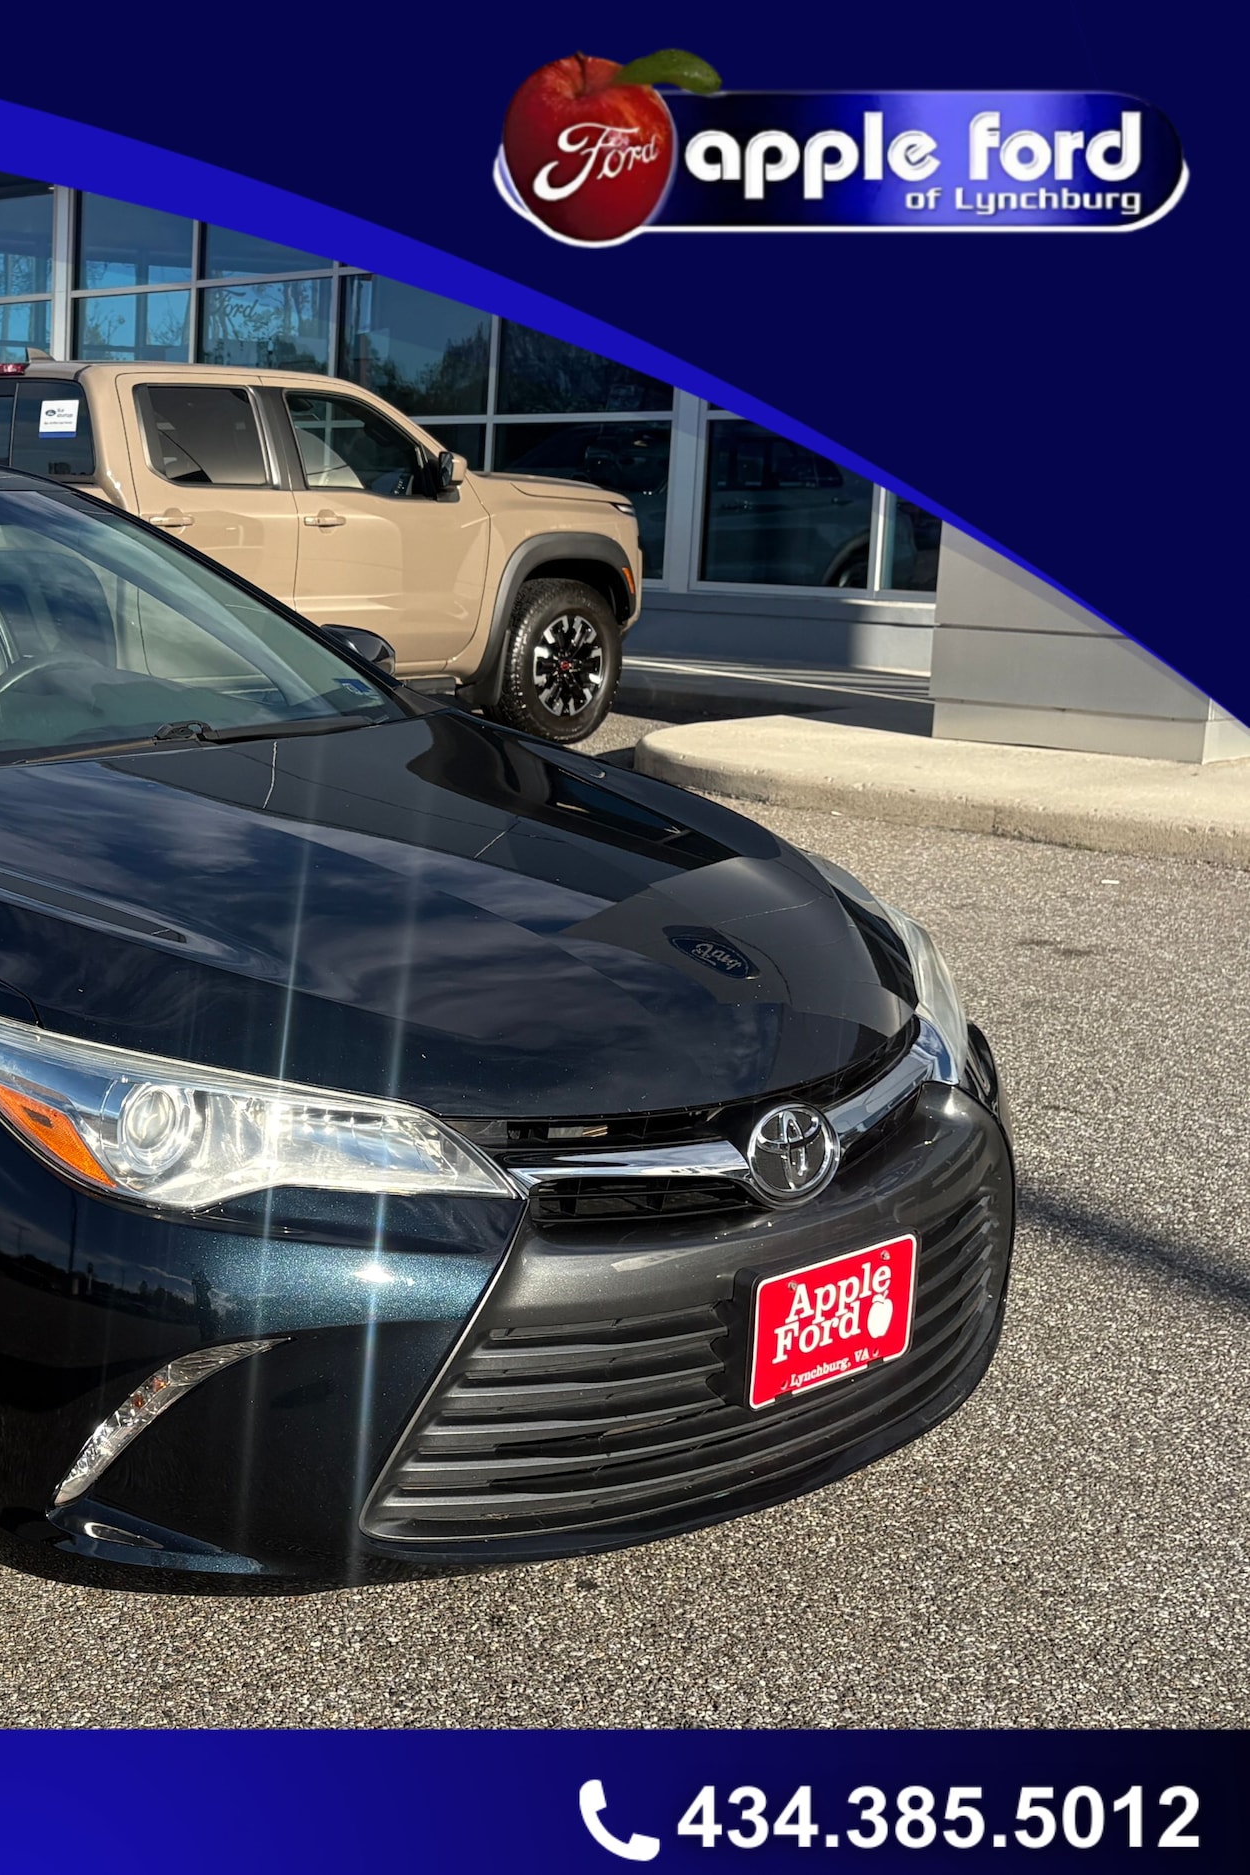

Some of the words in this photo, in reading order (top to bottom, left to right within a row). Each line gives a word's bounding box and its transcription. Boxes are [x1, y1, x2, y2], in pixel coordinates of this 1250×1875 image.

[208, 289, 260, 318] Ford
[785, 1262, 892, 1325] Apple
[772, 1301, 861, 1364] Ford
[789, 1357, 852, 1387] Lynchburg,
[854, 1347, 870, 1363] VA
